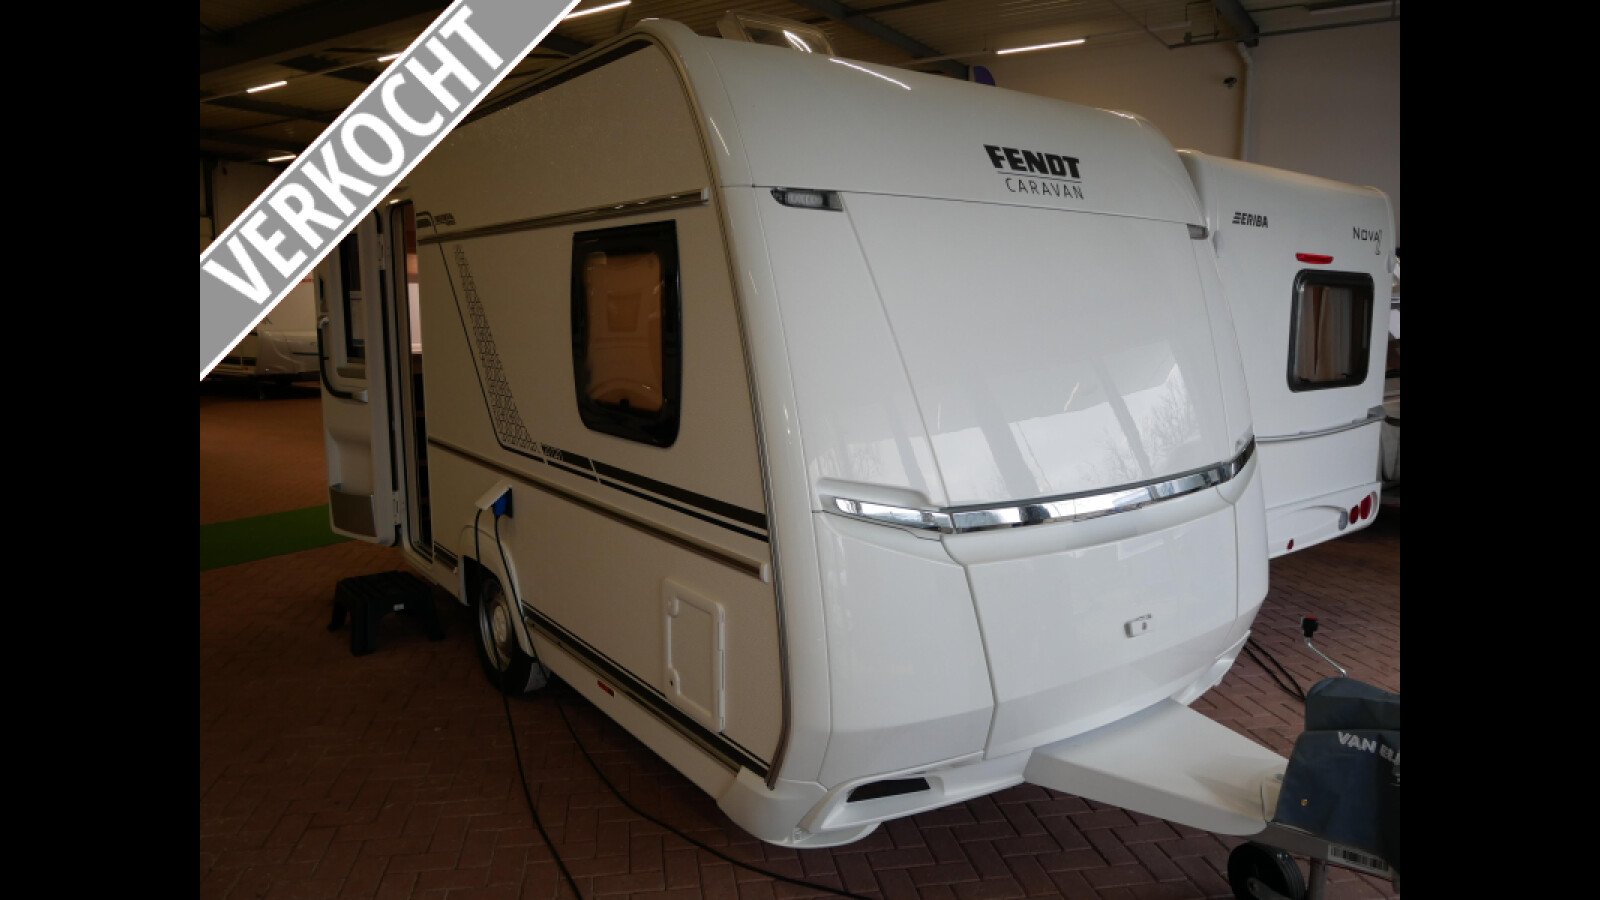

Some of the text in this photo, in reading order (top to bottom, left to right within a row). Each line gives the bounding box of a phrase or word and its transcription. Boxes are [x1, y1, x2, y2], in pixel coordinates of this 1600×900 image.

[983, 143, 1081, 179] FENDT
[1005, 177, 1084, 200] CARAVAN
[1239, 212, 1269, 229] ERIBA
[1352, 226, 1382, 243] NOVA
[1337, 731, 1377, 754] VAN
